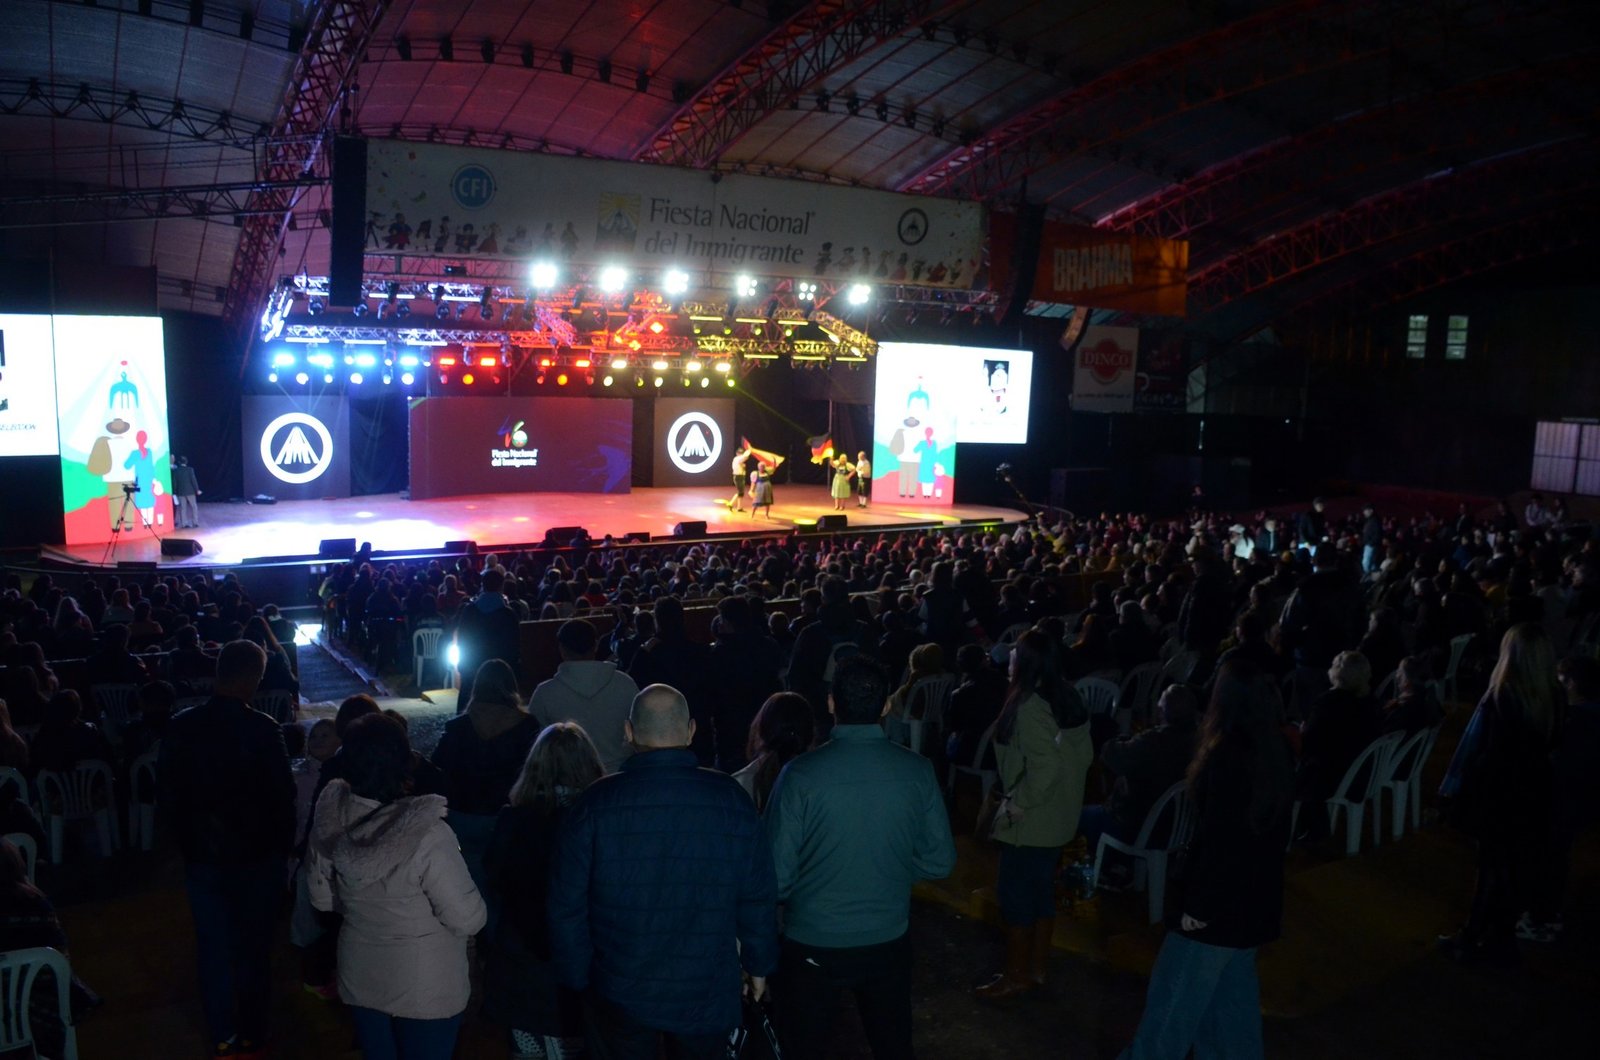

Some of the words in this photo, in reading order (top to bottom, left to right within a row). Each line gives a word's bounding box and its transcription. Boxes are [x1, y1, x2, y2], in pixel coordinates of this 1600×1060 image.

[459, 178, 488, 198] CFI
[649, 198, 713, 227] Fiesta
[720, 203, 811, 236] Nacional
[644, 231, 679, 255] del
[684, 233, 804, 264] Inmigrante
[1053, 243, 1134, 293] BRAHMA
[1084, 351, 1130, 367] DINCO
